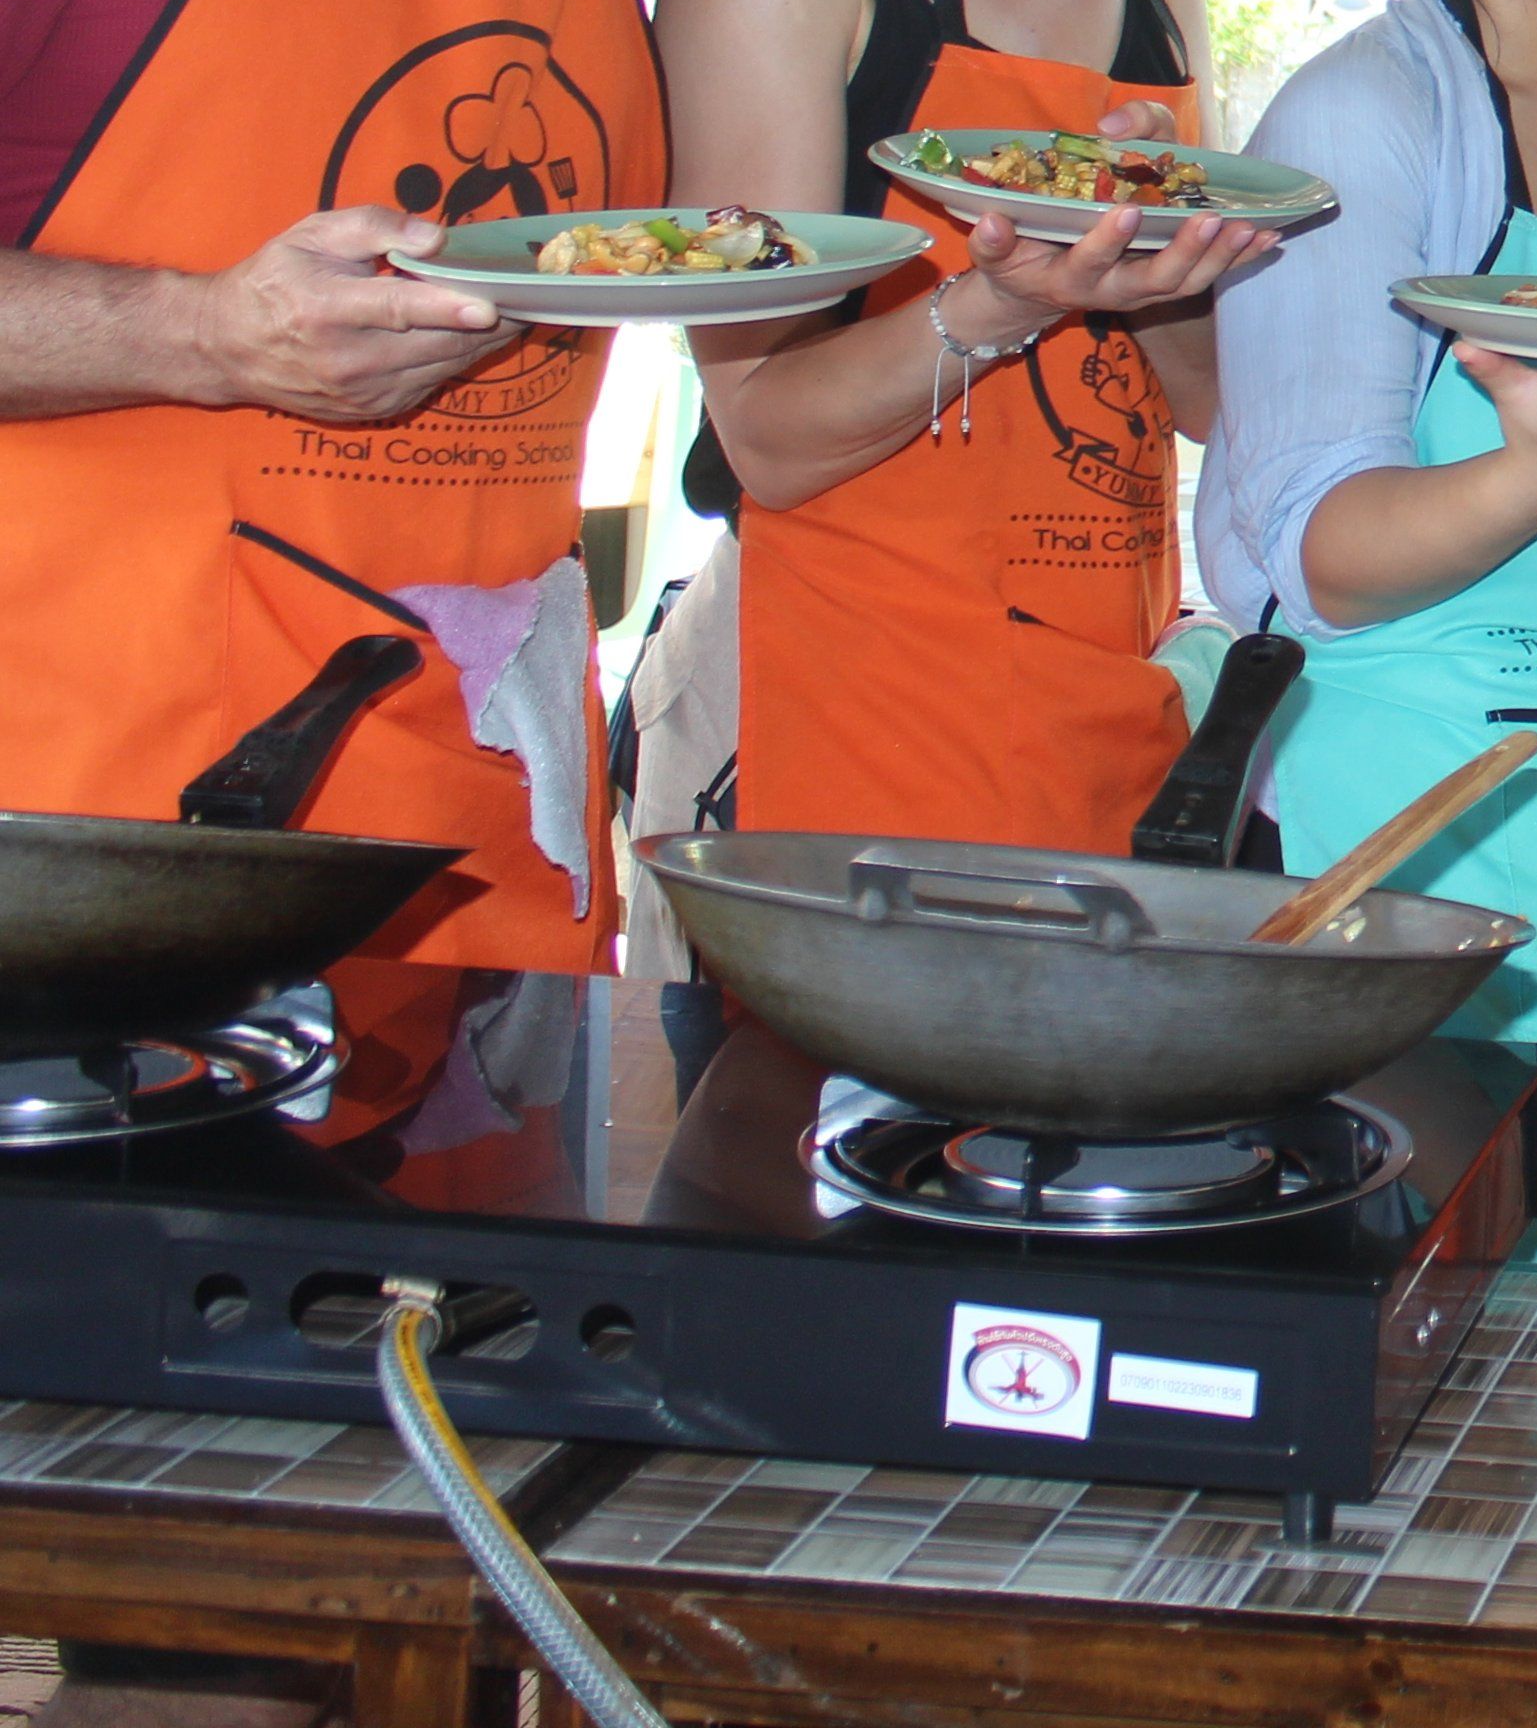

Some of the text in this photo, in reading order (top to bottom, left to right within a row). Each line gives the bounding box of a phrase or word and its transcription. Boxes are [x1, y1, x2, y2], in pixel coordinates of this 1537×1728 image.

[294, 429, 372, 460] Thai
[385, 439, 507, 471] Cooking
[1033, 529, 1091, 551] Thai
